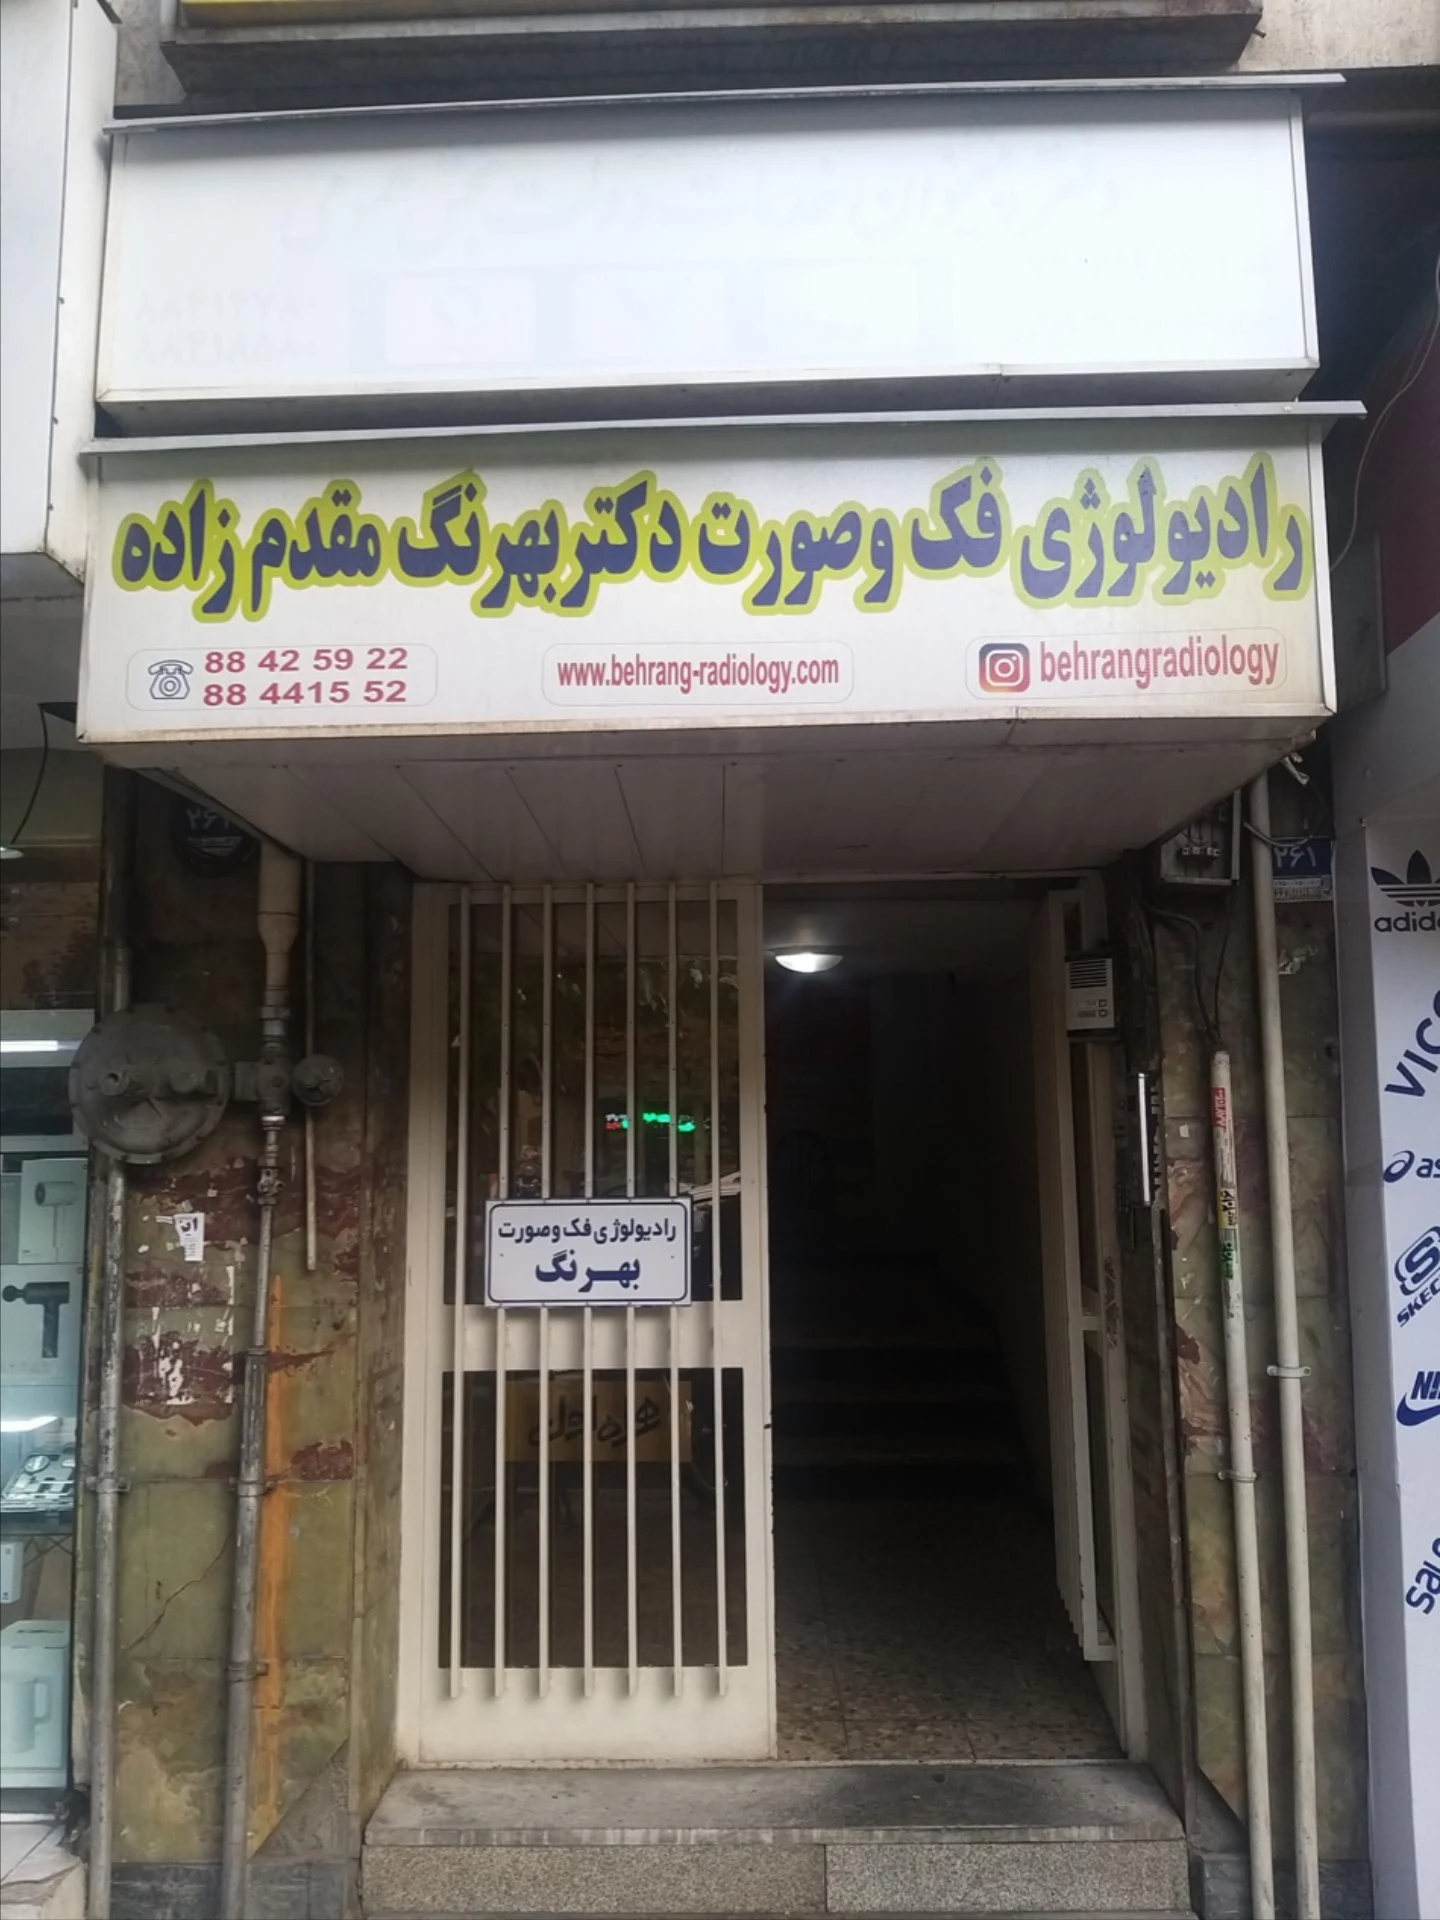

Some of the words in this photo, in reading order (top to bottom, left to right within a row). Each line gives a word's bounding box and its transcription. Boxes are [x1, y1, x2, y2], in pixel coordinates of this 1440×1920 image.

[911, 467, 1001, 570] فک
[1021, 463, 1301, 599] رادیولوژی
[120, 488, 234, 614] زاده
[251, 489, 380, 617] مقدم
[398, 483, 560, 609] بهرنگ
[560, 481, 682, 608] دکتر
[204, 650, 246, 674] 88
[257, 649, 301, 673] 42
[312, 648, 354, 671] 59
[366, 647, 408, 670] 22
[557, 653, 839, 695] www.behrang-radiology.com
[1040, 634, 1279, 690] behrangradiology
[203, 682, 247, 707] 88
[363, 680, 407, 704] 52
[1274, 845, 1317, 869] ۲۶۱
[1374, 911, 1440, 933] adid
[1384, 989, 1440, 1097] VIC
[563, 1217, 592, 1237] فک
[593, 1217, 677, 1245] رادیولوژی
[535, 1249, 641, 1293] بهرنگ
[1411, 1370, 1440, 1400] NI
